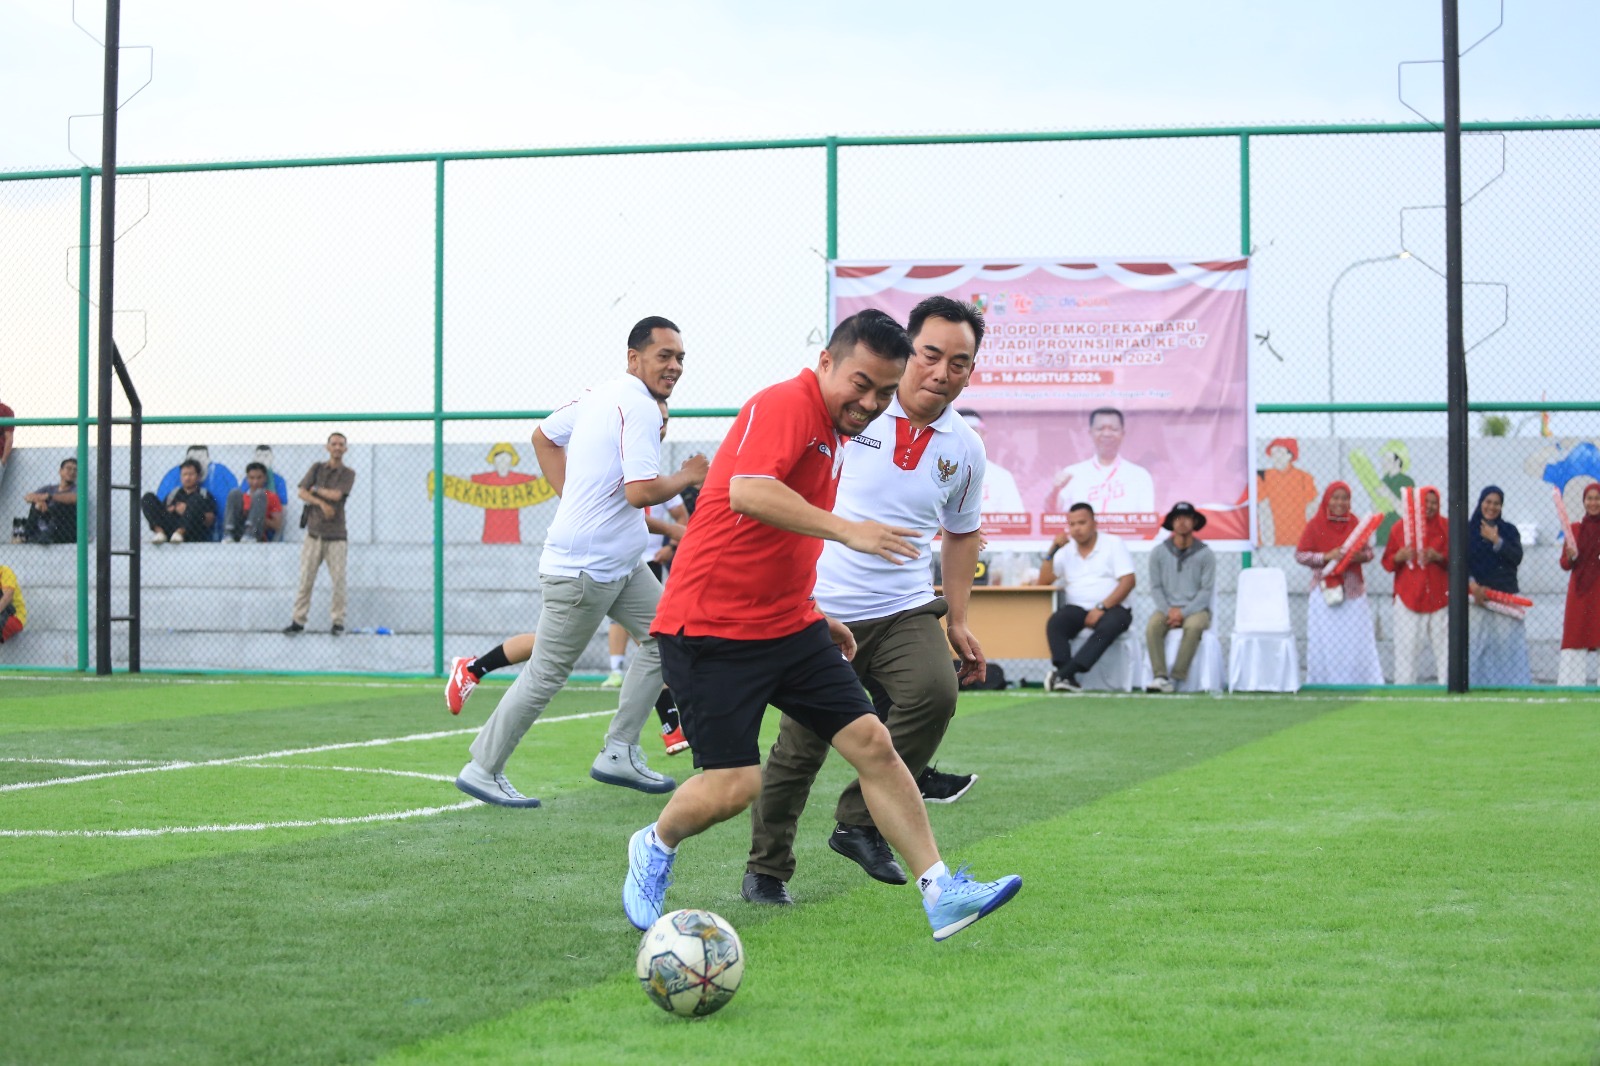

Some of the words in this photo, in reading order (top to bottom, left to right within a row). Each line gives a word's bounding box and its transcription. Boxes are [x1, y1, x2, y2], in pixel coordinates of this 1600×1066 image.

[1007, 323, 1038, 335] OPD
[1043, 323, 1098, 335] PEMKO
[1102, 321, 1197, 334] PEKANBARU
[998, 340, 1032, 350] JADI
[1037, 339, 1110, 350] PROVINSI
[1115, 338, 1151, 349] RIAU
[1156, 337, 1176, 348] KE
[1188, 335, 1206, 347] 67
[995, 354, 1010, 364] RI
[1015, 354, 1034, 364] KE
[1043, 353, 1066, 365] 79
[1071, 353, 1123, 364] TAHUN
[1127, 352, 1162, 364] 2024
[981, 372, 993, 383] 15
[1002, 372, 1014, 383] 16
[1015, 372, 1069, 383] AGUSTUS
[1071, 372, 1102, 383] 2024
[851, 434, 880, 448] CURVA
[444, 476, 551, 506] PEKANBARU
